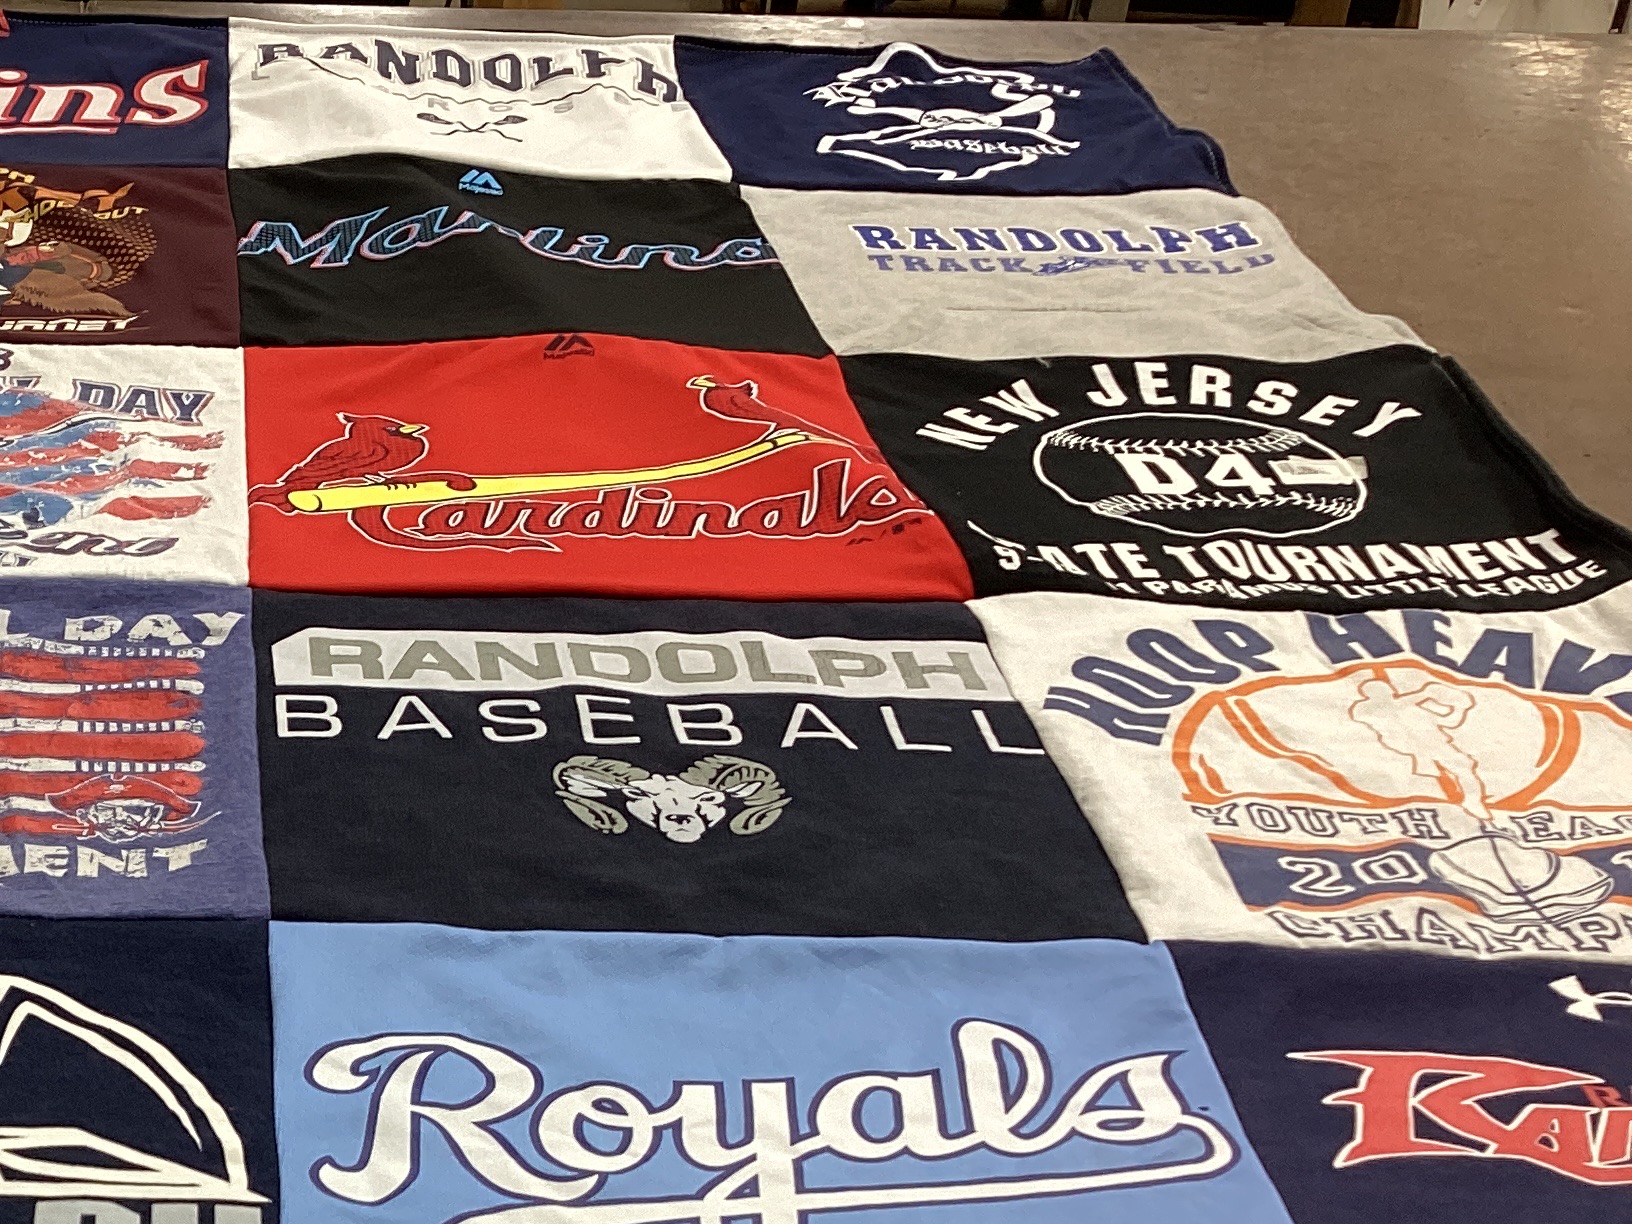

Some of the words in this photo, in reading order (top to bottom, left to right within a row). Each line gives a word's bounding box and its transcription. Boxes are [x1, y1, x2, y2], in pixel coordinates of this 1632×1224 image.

[850, 222, 1264, 254] RANDOLPH
[867, 254, 1033, 273] TRACK
[71, 378, 218, 428] DAY
[915, 378, 1061, 452] NEW
[1084, 361, 1424, 440] JERSEY
[346, 459, 935, 552] Cardinals
[1162, 528, 1582, 583] TOURNAMENT
[1460, 560, 1609, 598] LEAGUE
[65, 611, 246, 648] DAY
[308, 634, 987, 692] RANDOLPH
[1043, 618, 1276, 747] HOOP
[274, 694, 1048, 757] BASEBALL
[1191, 802, 1451, 840] YOUTH
